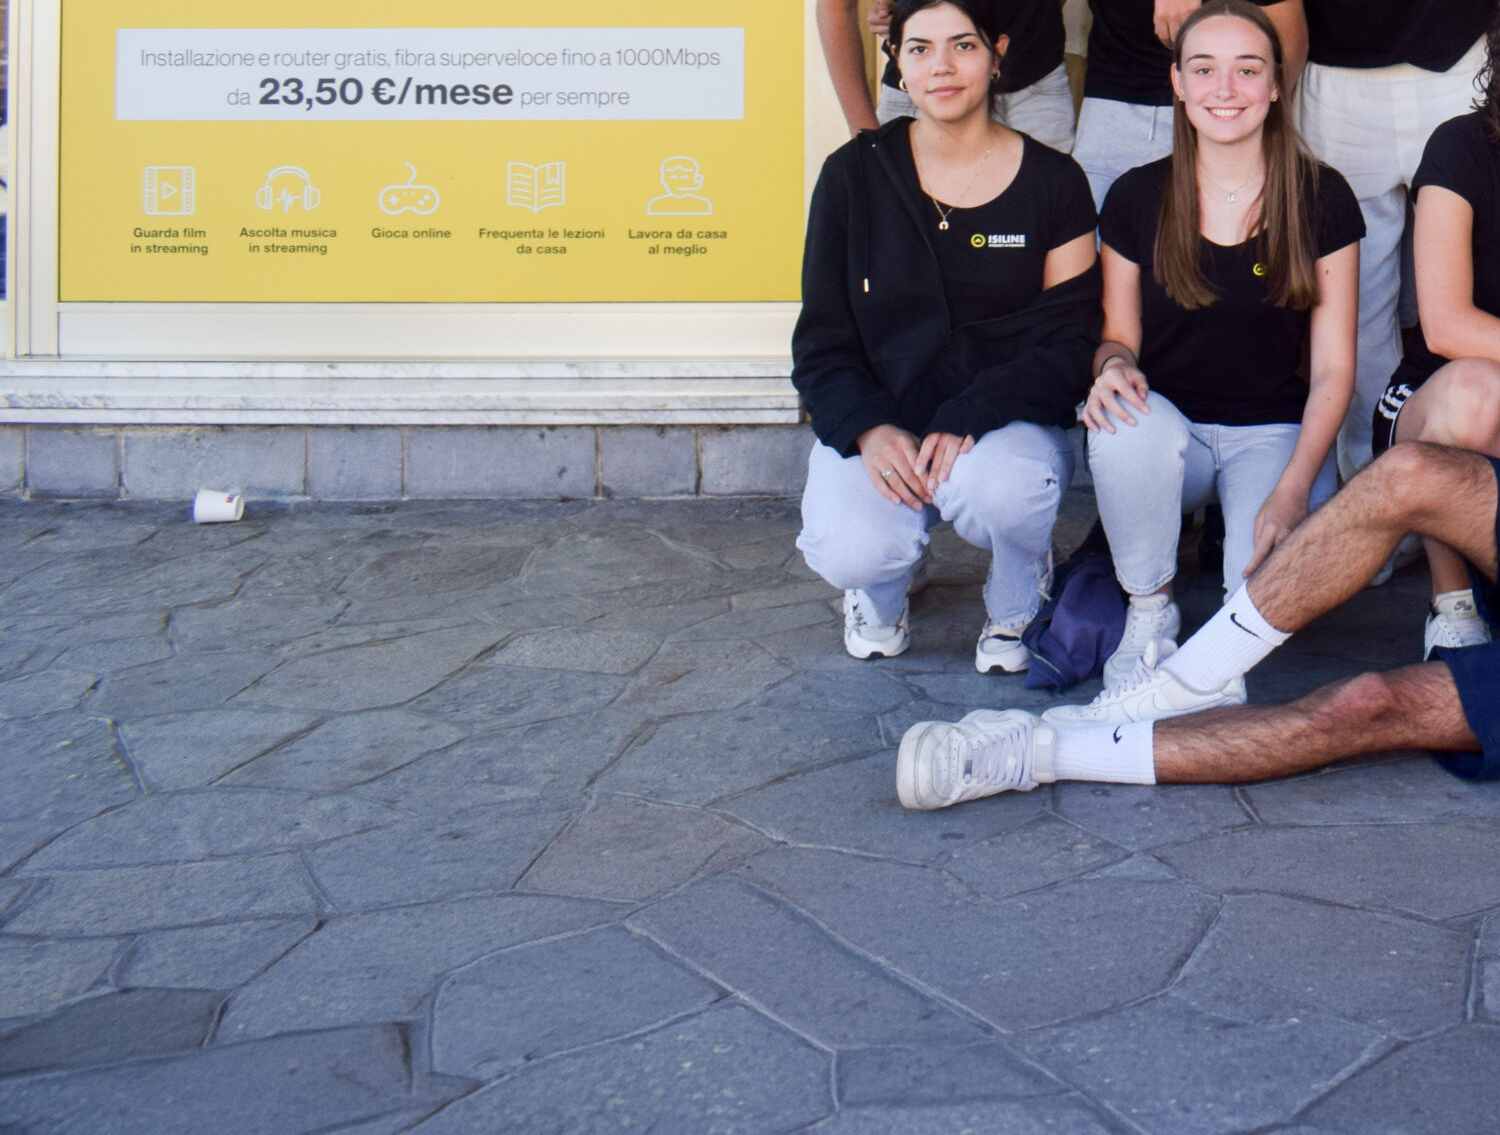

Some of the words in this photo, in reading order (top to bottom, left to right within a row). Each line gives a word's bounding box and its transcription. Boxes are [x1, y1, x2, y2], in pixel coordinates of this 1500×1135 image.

[140, 48, 255, 67] Installazione
[258, 53, 271, 67] e
[274, 51, 329, 67] router
[333, 49, 391, 71] gratis,
[394, 48, 436, 67] fibra
[440, 48, 558, 70] superveloce
[561, 48, 596, 67] fino
[599, 53, 612, 67] a
[616, 48, 721, 70] 1000Mbps
[226, 88, 251, 106] da
[258, 77, 364, 112] 23,50
[370, 76, 514, 106] €/mese
[520, 90, 552, 109] per
[556, 90, 631, 109] sempre
[132, 227, 179, 239] Guarda
[182, 227, 207, 238] film
[239, 226, 288, 238] Ascolta
[290, 227, 337, 238] musica
[371, 227, 409, 239] Gioca
[412, 227, 452, 239] online
[478, 227, 545, 241] Frequenta
[547, 228, 560, 239] le
[563, 228, 606, 239] lezioni
[628, 228, 673, 240] Lavora
[676, 228, 693, 240] da
[696, 230, 728, 240] casa
[987, 234, 1026, 244] ISILINE
[130, 243, 142, 254] in
[145, 244, 209, 257] streaming
[248, 243, 261, 253] in
[263, 243, 328, 256] streaming
[516, 243, 533, 255] da
[536, 245, 567, 255] casa
[648, 244, 660, 255] al
[663, 244, 708, 258] meglio
